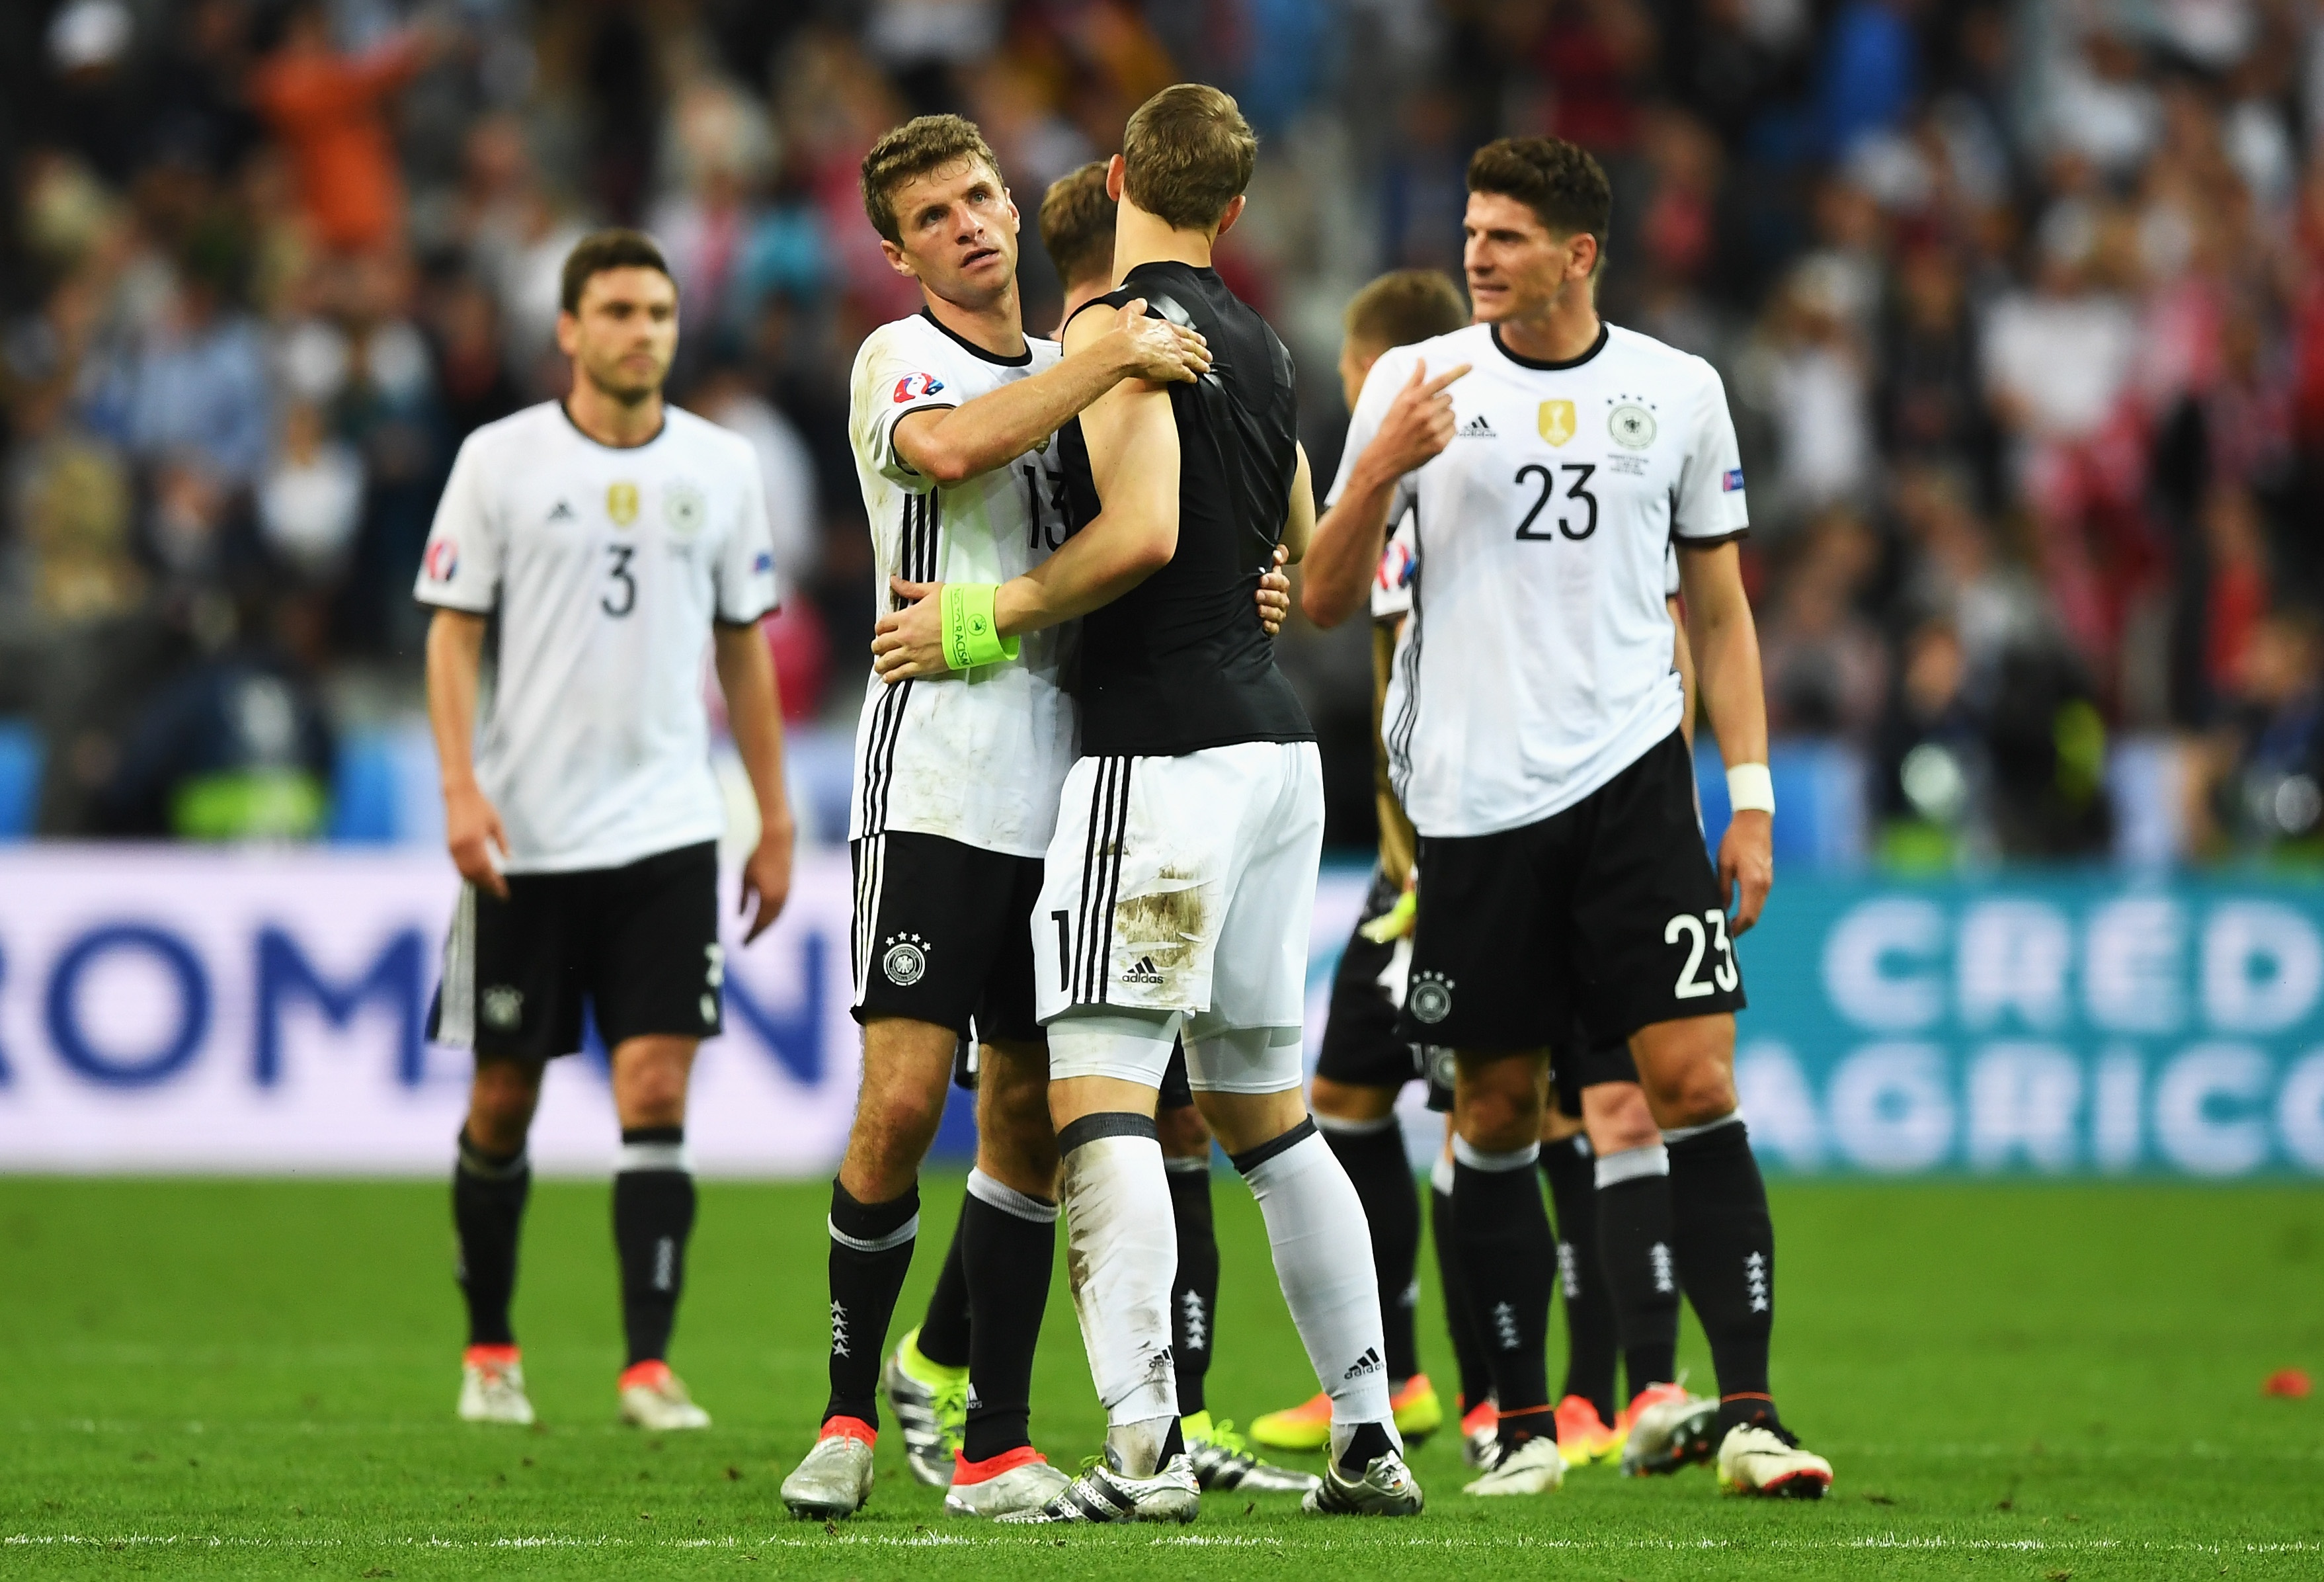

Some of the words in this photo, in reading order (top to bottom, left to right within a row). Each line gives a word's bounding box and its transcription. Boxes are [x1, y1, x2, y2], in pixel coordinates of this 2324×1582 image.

[1023, 465, 1070, 552] 13
[1515, 464, 1597, 541] 23
[601, 544, 636, 618] 3
[954, 625, 970, 666] RACISM
[1051, 910, 1070, 992] 1
[1122, 974, 1164, 983] adidas
[1664, 909, 1738, 999] 23
[0, 923, 828, 1090] OMN
